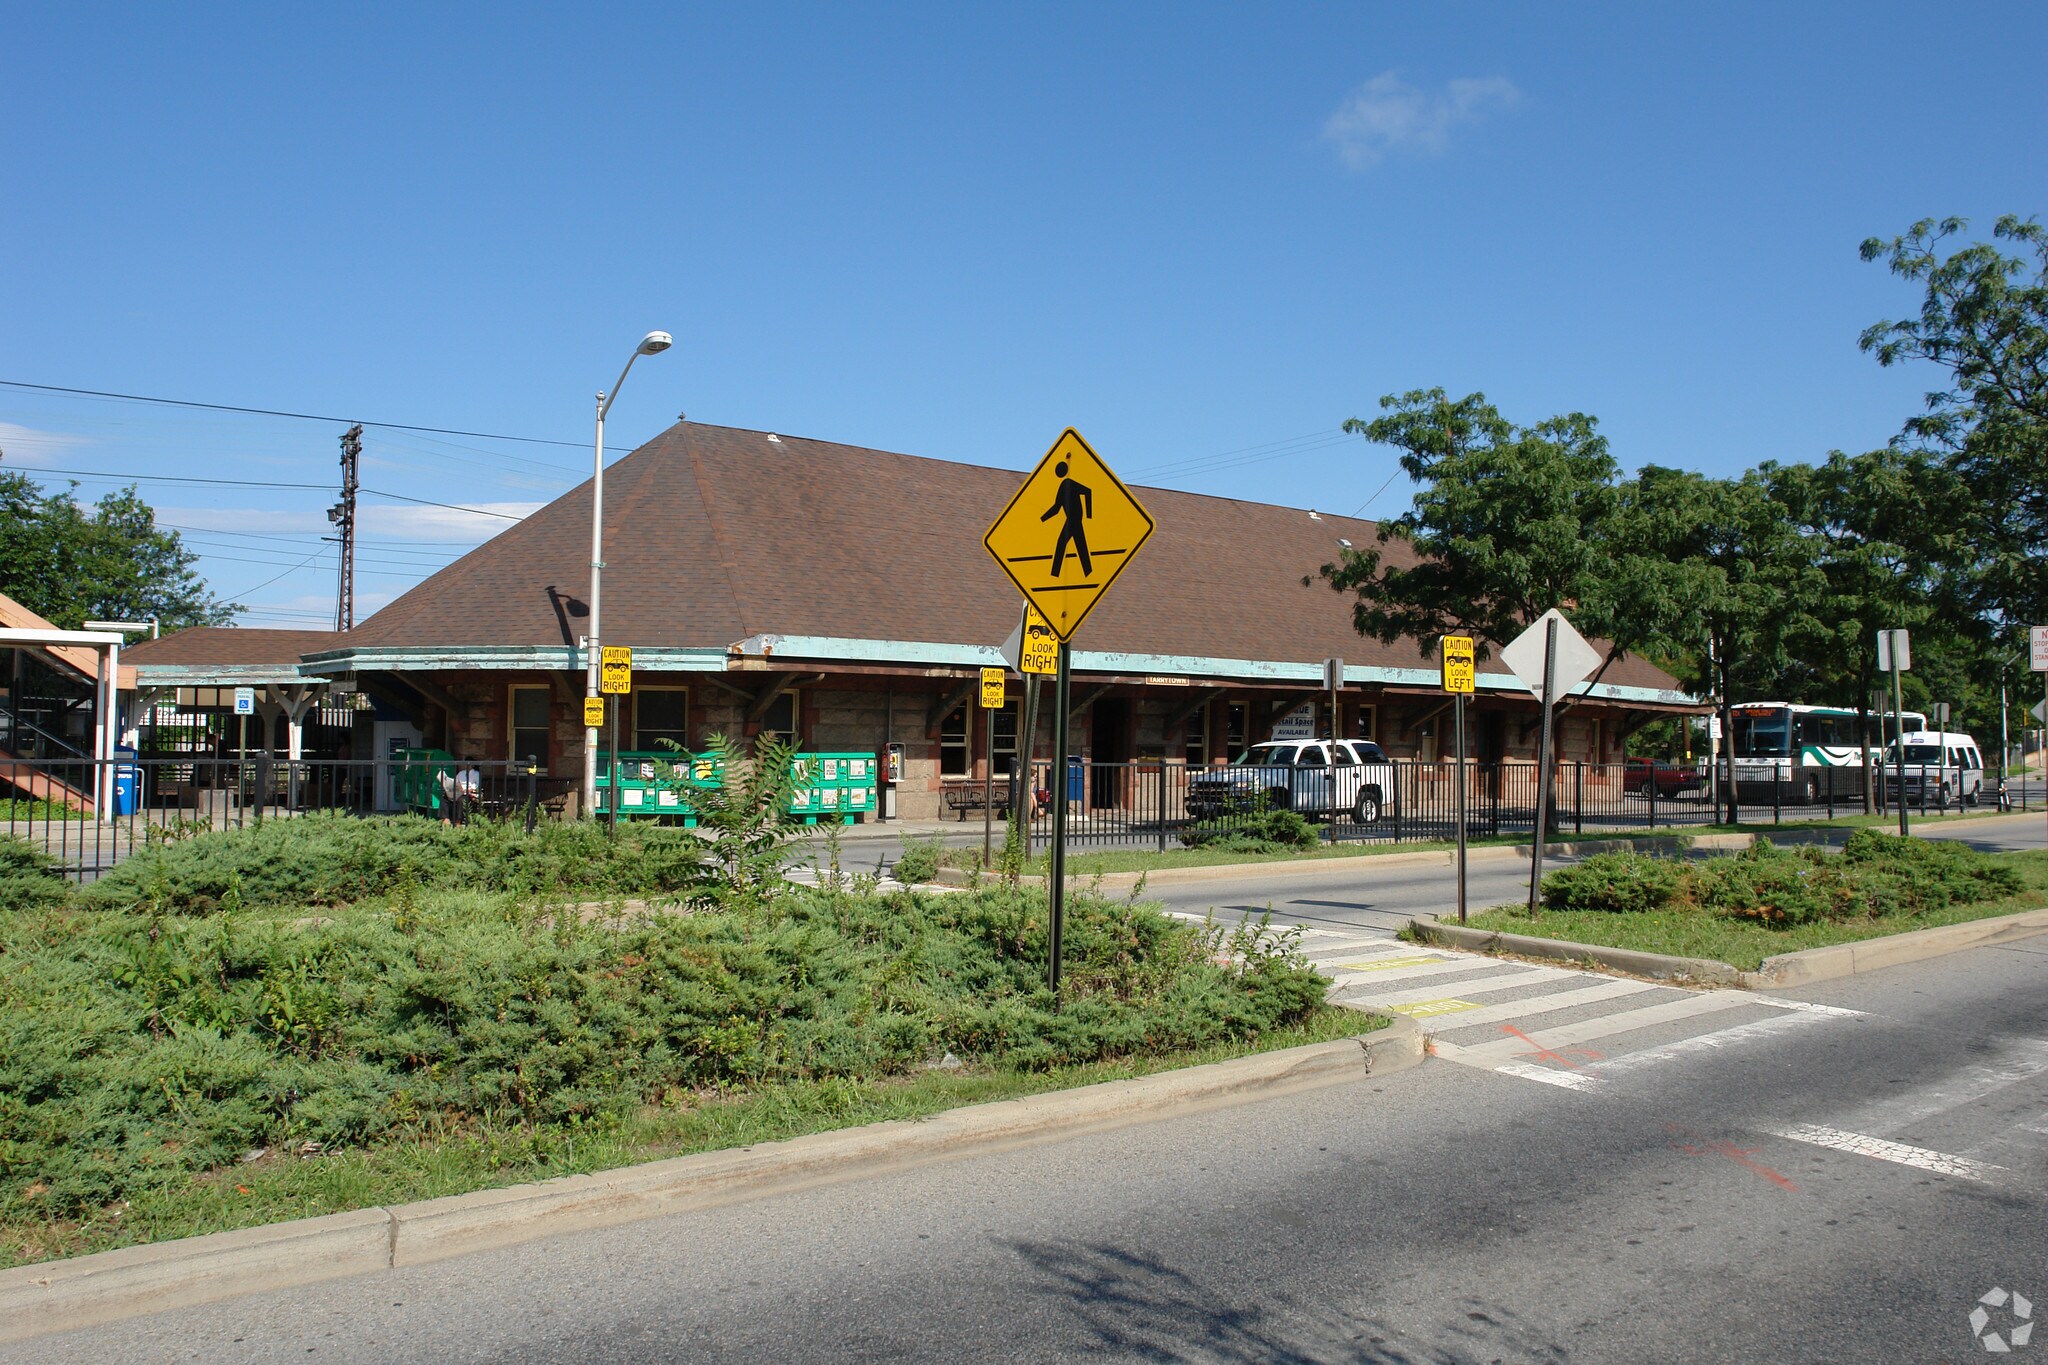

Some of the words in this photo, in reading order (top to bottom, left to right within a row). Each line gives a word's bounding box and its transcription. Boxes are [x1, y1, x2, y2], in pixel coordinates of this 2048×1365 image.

[1032, 643, 1054, 654] LOOK
[1446, 639, 1472, 650] CAUTION
[603, 649, 630, 659] CAUTION
[1023, 653, 1058, 669] RIGHT
[983, 669, 1004, 679] CAUTION
[603, 681, 630, 691] RIGHT
[1448, 678, 1471, 689] LEFT
[983, 697, 1003, 706] RIGHT
[1295, 717, 1314, 728] Space
